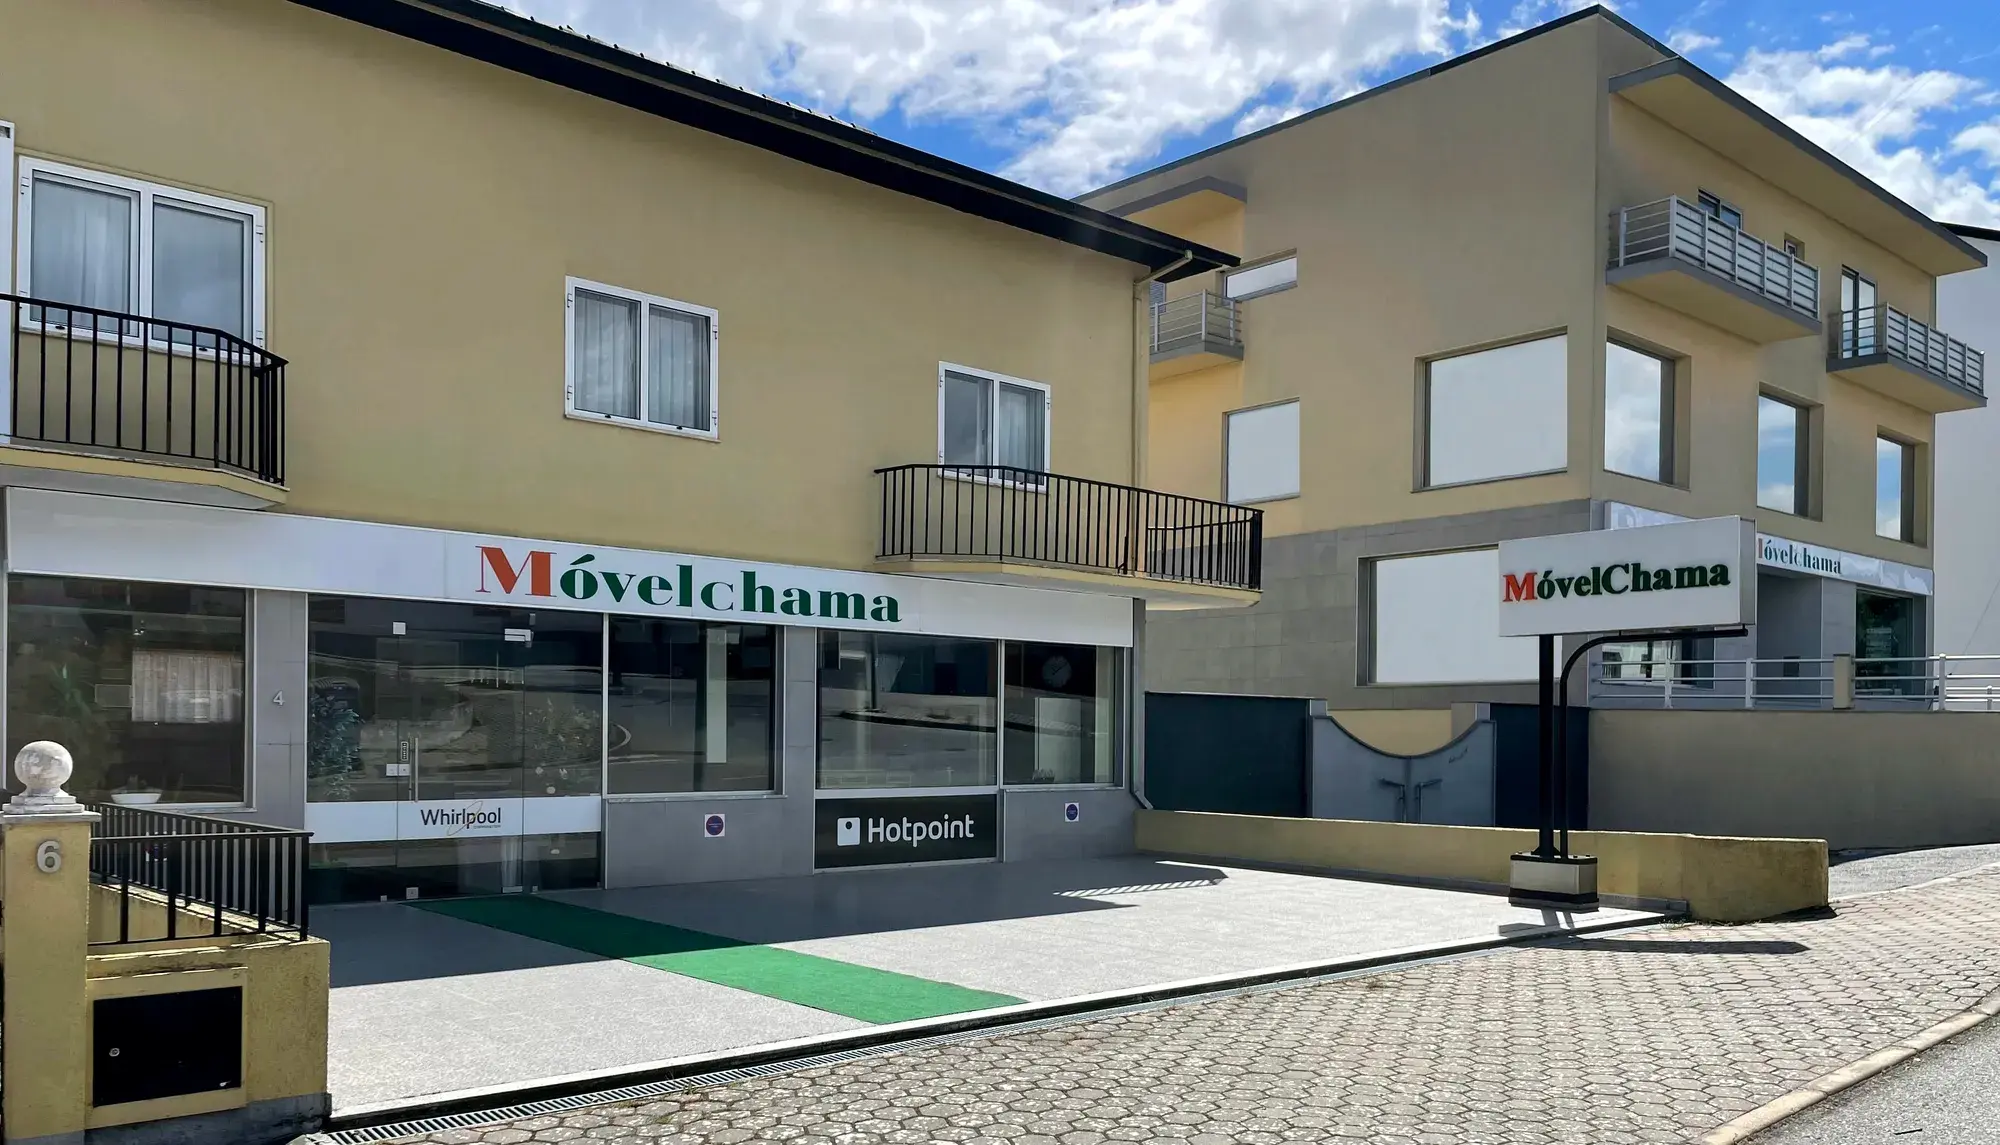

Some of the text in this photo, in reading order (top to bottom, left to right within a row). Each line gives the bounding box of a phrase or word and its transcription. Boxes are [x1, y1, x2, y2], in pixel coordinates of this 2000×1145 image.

[475, 545, 902, 622] Móvelchama
[1503, 563, 1731, 602] MóvelChama
[273, 690, 285, 706] 4
[420, 807, 502, 830] Whirlpool
[868, 814, 975, 848] Hotpoint
[37, 840, 62, 873] 6
